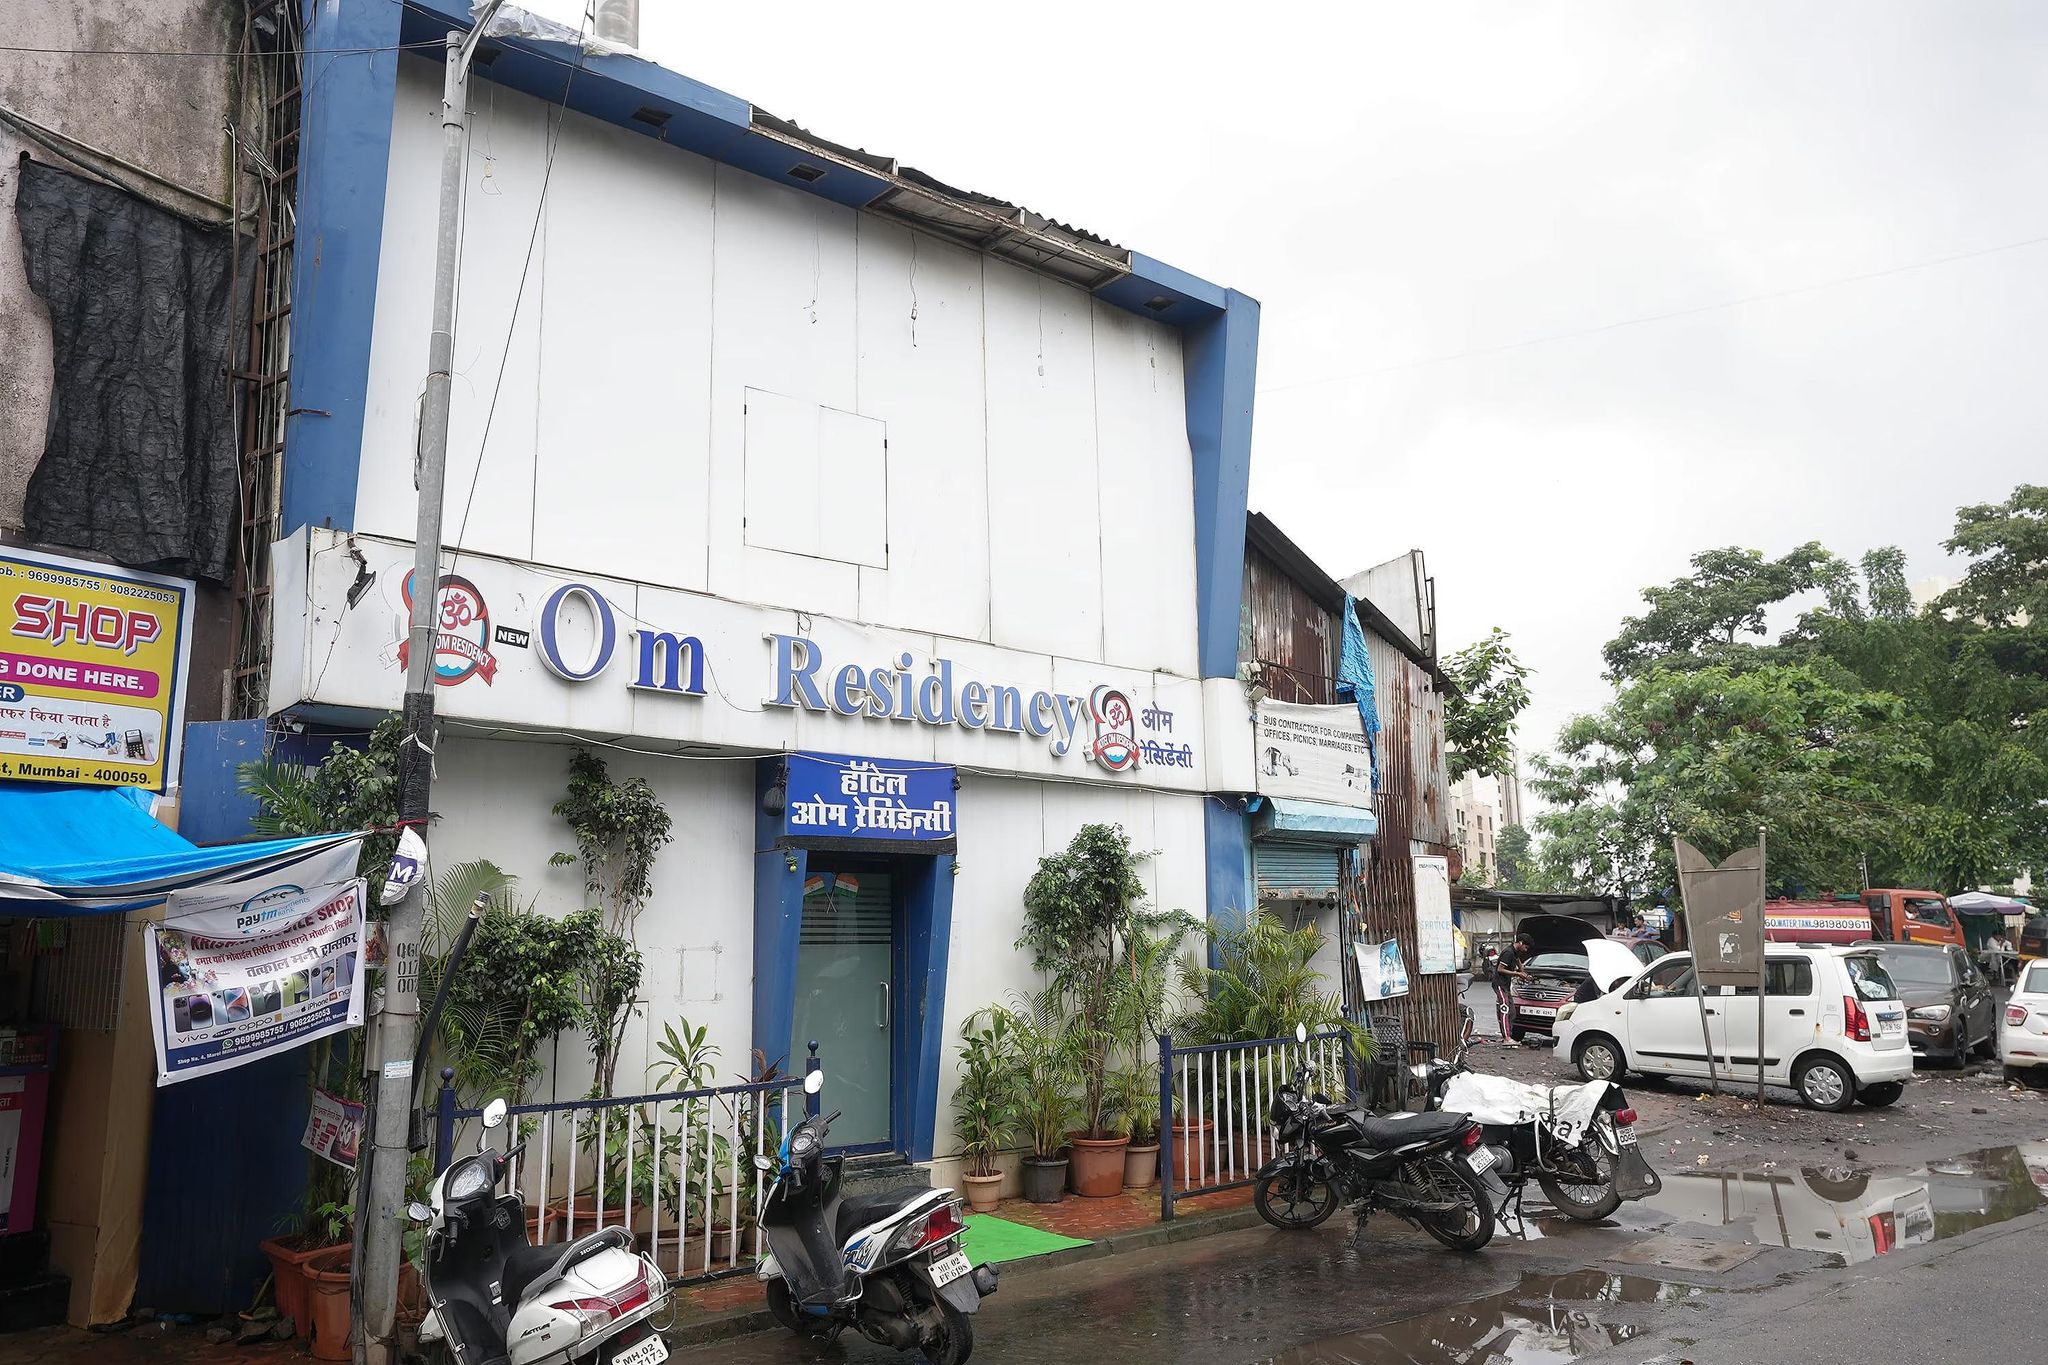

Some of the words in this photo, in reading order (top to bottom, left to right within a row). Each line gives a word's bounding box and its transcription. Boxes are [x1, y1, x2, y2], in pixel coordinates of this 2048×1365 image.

[28, 570, 100, 591] 9699985755
[110, 584, 175, 603] 9082225053
[11, 593, 161, 656] SHOP
[497, 630, 528, 645] NEW
[436, 635, 450, 649] OM
[451, 636, 491, 667] RESIDENCY
[16, 661, 77, 682] DONE
[84, 670, 144, 691] HERE.
[536, 582, 708, 697] Om
[763, 632, 1086, 757] Residency
[29, 707, 64, 723] किया
[67, 714, 99, 727] जाता
[102, 714, 112, 728] है
[1141, 700, 1173, 733] ओम
[1263, 715, 1277, 727] BUS
[1278, 718, 1320, 735] CONTRACTOR
[1320, 727, 1332, 736] FOR
[1263, 728, 1292, 742] OFFICES,
[1293, 734, 1318, 746] PICNICS,
[1140, 739, 1193, 768] रेसिडेंसी
[18, 762, 79, 779] Mumbai
[93, 769, 151, 784] 400059.
[839, 760, 908, 796] हॉटेल
[791, 793, 848, 827] ओम
[852, 795, 952, 836] रेसिडेन्सी
[317, 895, 354, 921] SHOP
[1813, 919, 1870, 929] 9819809611
[178, 1033, 208, 1044] vivo
[239, 1017, 272, 1031] oppo
[235, 1024, 284, 1046] 9699985755
[579, 1240, 605, 1256] HONDA
[950, 1256, 960, 1267] 02
